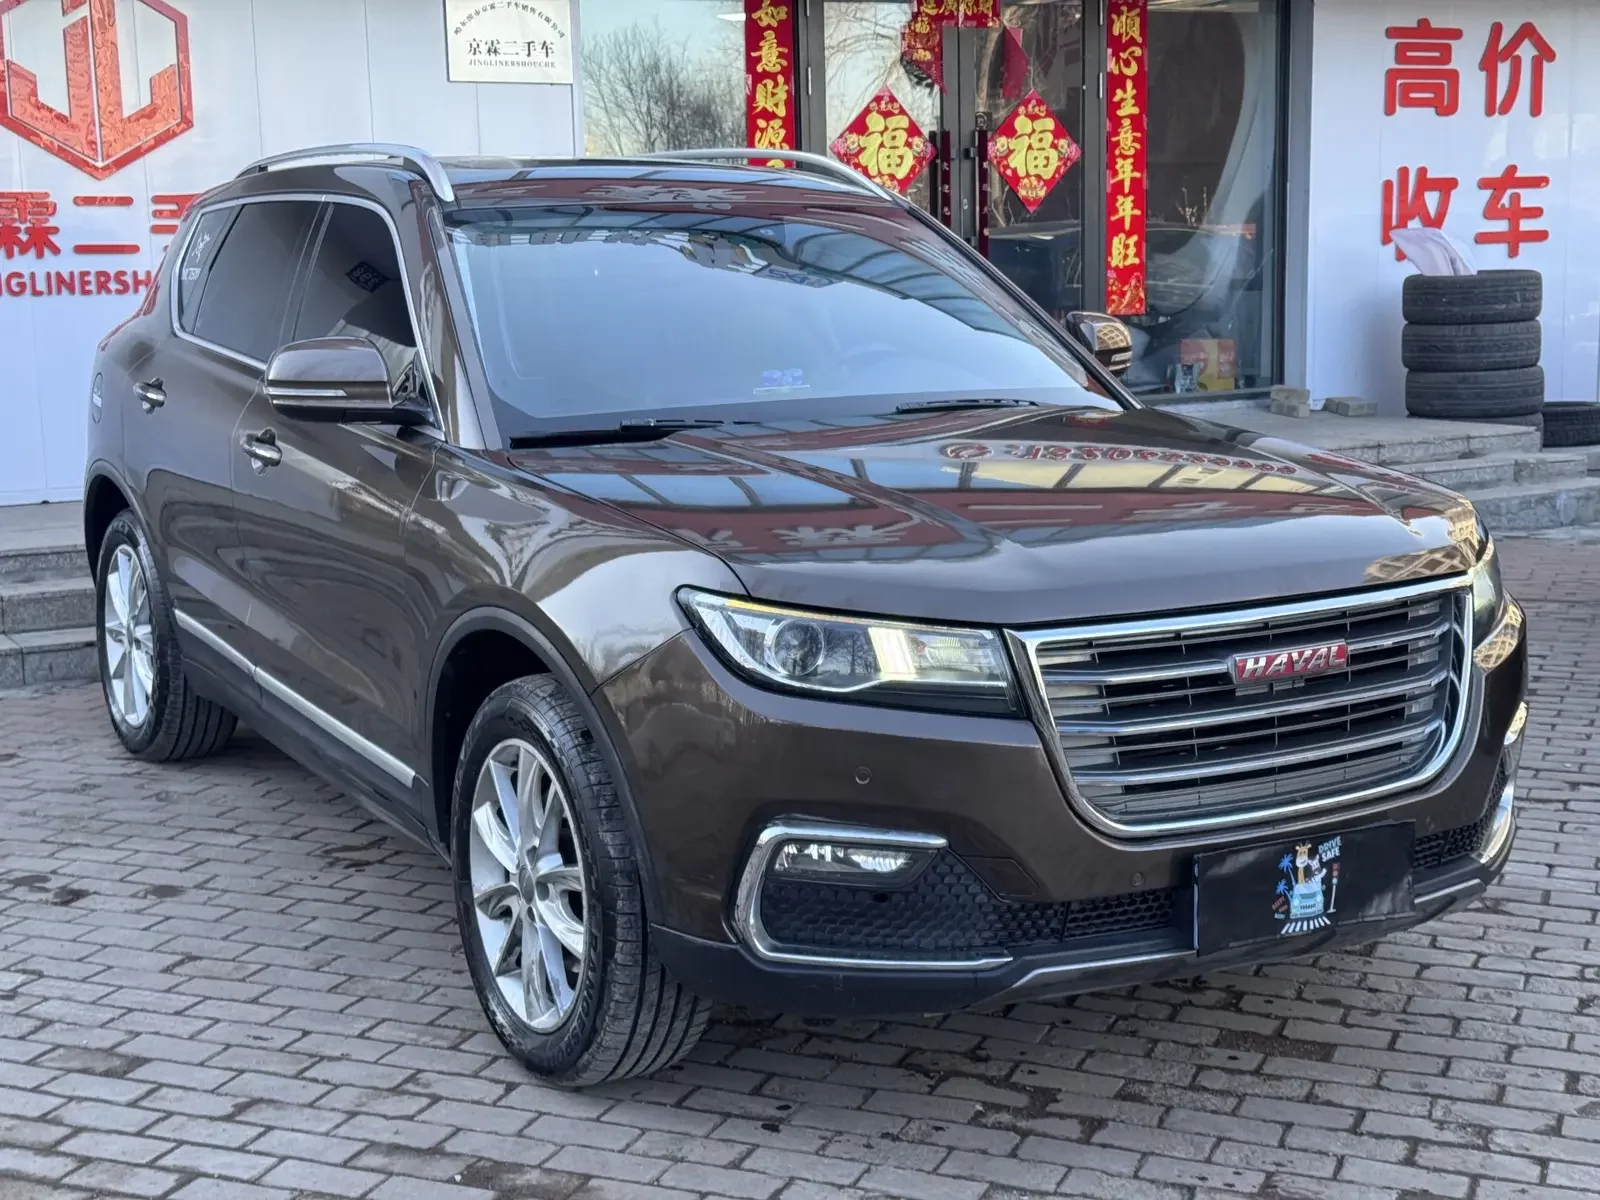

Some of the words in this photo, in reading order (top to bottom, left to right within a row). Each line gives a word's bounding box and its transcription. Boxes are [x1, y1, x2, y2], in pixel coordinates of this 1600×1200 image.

[465, 38, 555, 58] 京霖二手车
[468, 59, 556, 68] JINGLINERSHOUCHE
[1384, 17, 1557, 118] 高价
[859, 111, 914, 179] 福
[1008, 115, 1059, 180] 福
[1381, 164, 1550, 261] 收车
[0, 270, 152, 297] GLINERSH
[1242, 646, 1346, 678] HAVAL
[1318, 835, 1342, 854] DRIVE
[1321, 846, 1341, 862] SAFE
